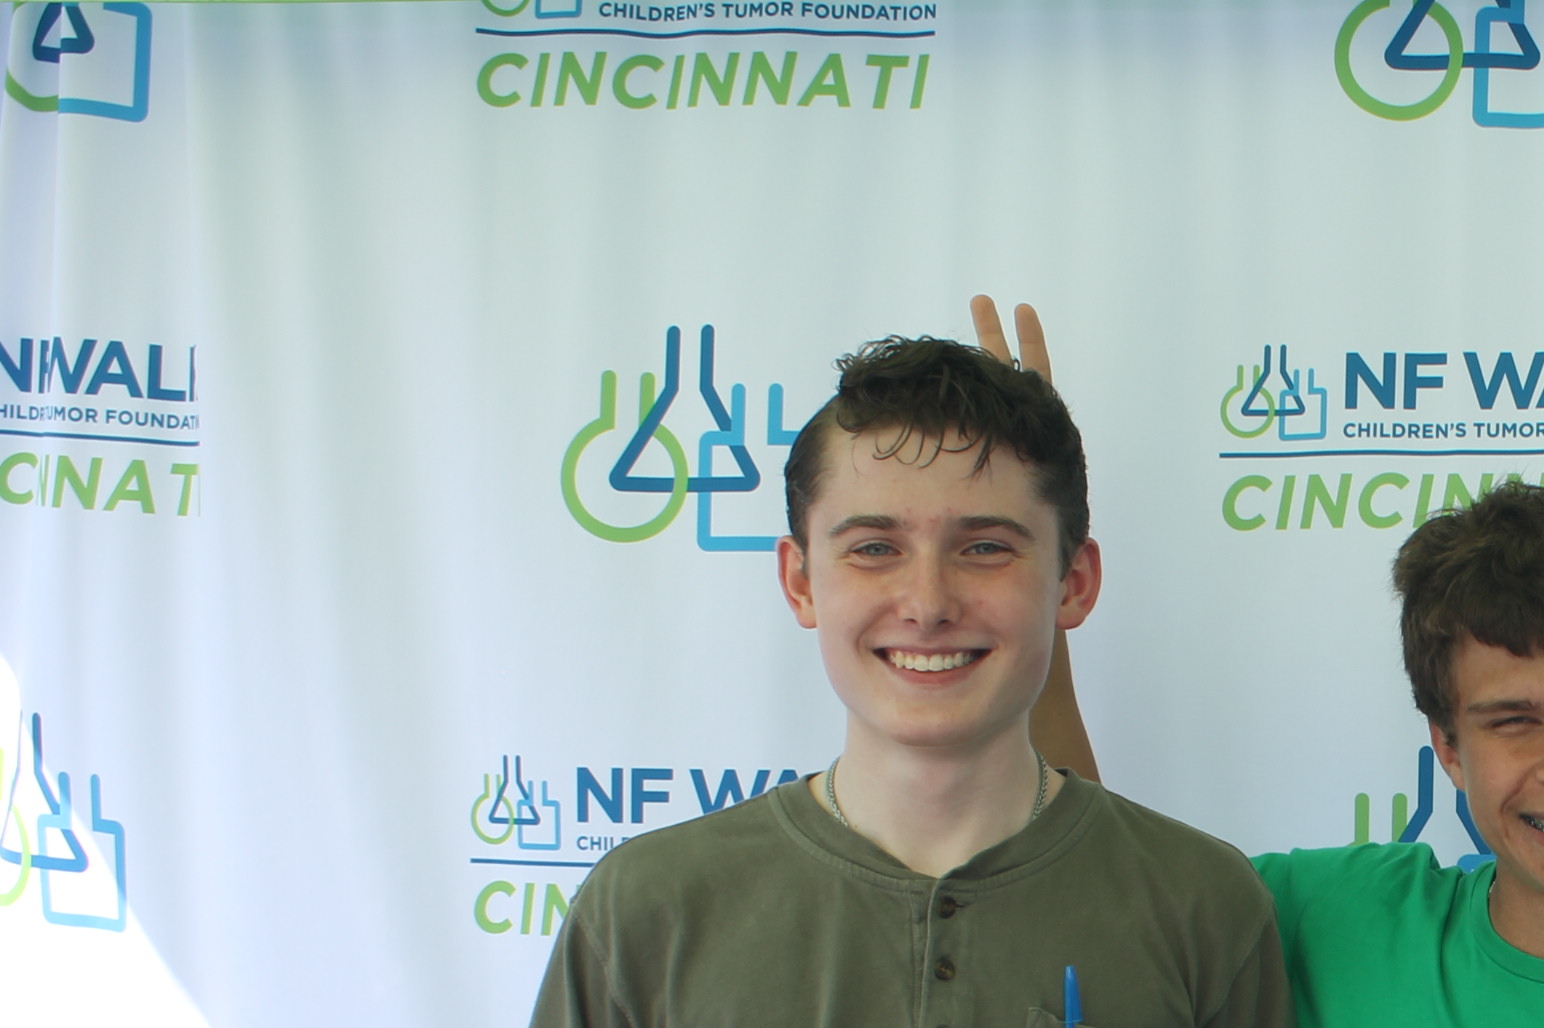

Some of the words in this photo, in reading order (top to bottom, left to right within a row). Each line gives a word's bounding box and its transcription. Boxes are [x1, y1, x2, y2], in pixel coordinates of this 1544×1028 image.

[599, 2, 715, 22] CHILDREN'S
[722, 1, 794, 18] TUMOR
[801, 2, 937, 21] FOUNDATION
[476, 51, 930, 109] CINCINNATI
[1344, 352, 1447, 410] NF
[1343, 422, 1467, 439] CHILDREN'S
[577, 767, 673, 824] NF
